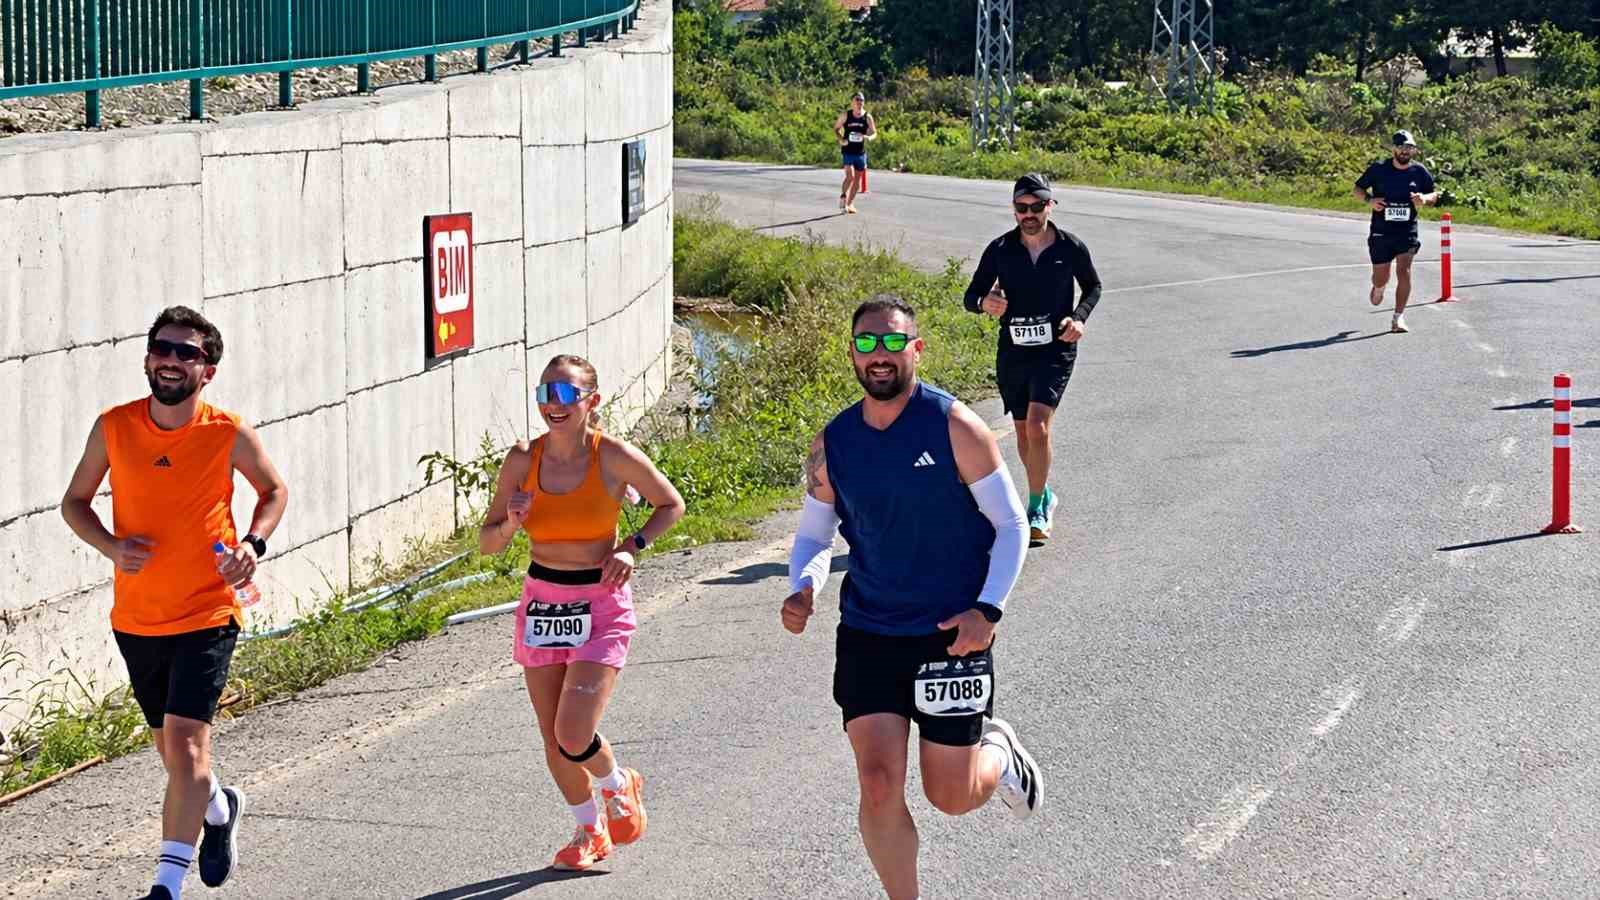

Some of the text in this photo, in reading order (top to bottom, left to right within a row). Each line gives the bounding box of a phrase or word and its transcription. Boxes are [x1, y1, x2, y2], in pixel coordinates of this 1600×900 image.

[1014, 326, 1046, 337] 57118
[533, 618, 583, 637] 57090
[925, 679, 983, 702] 57088
